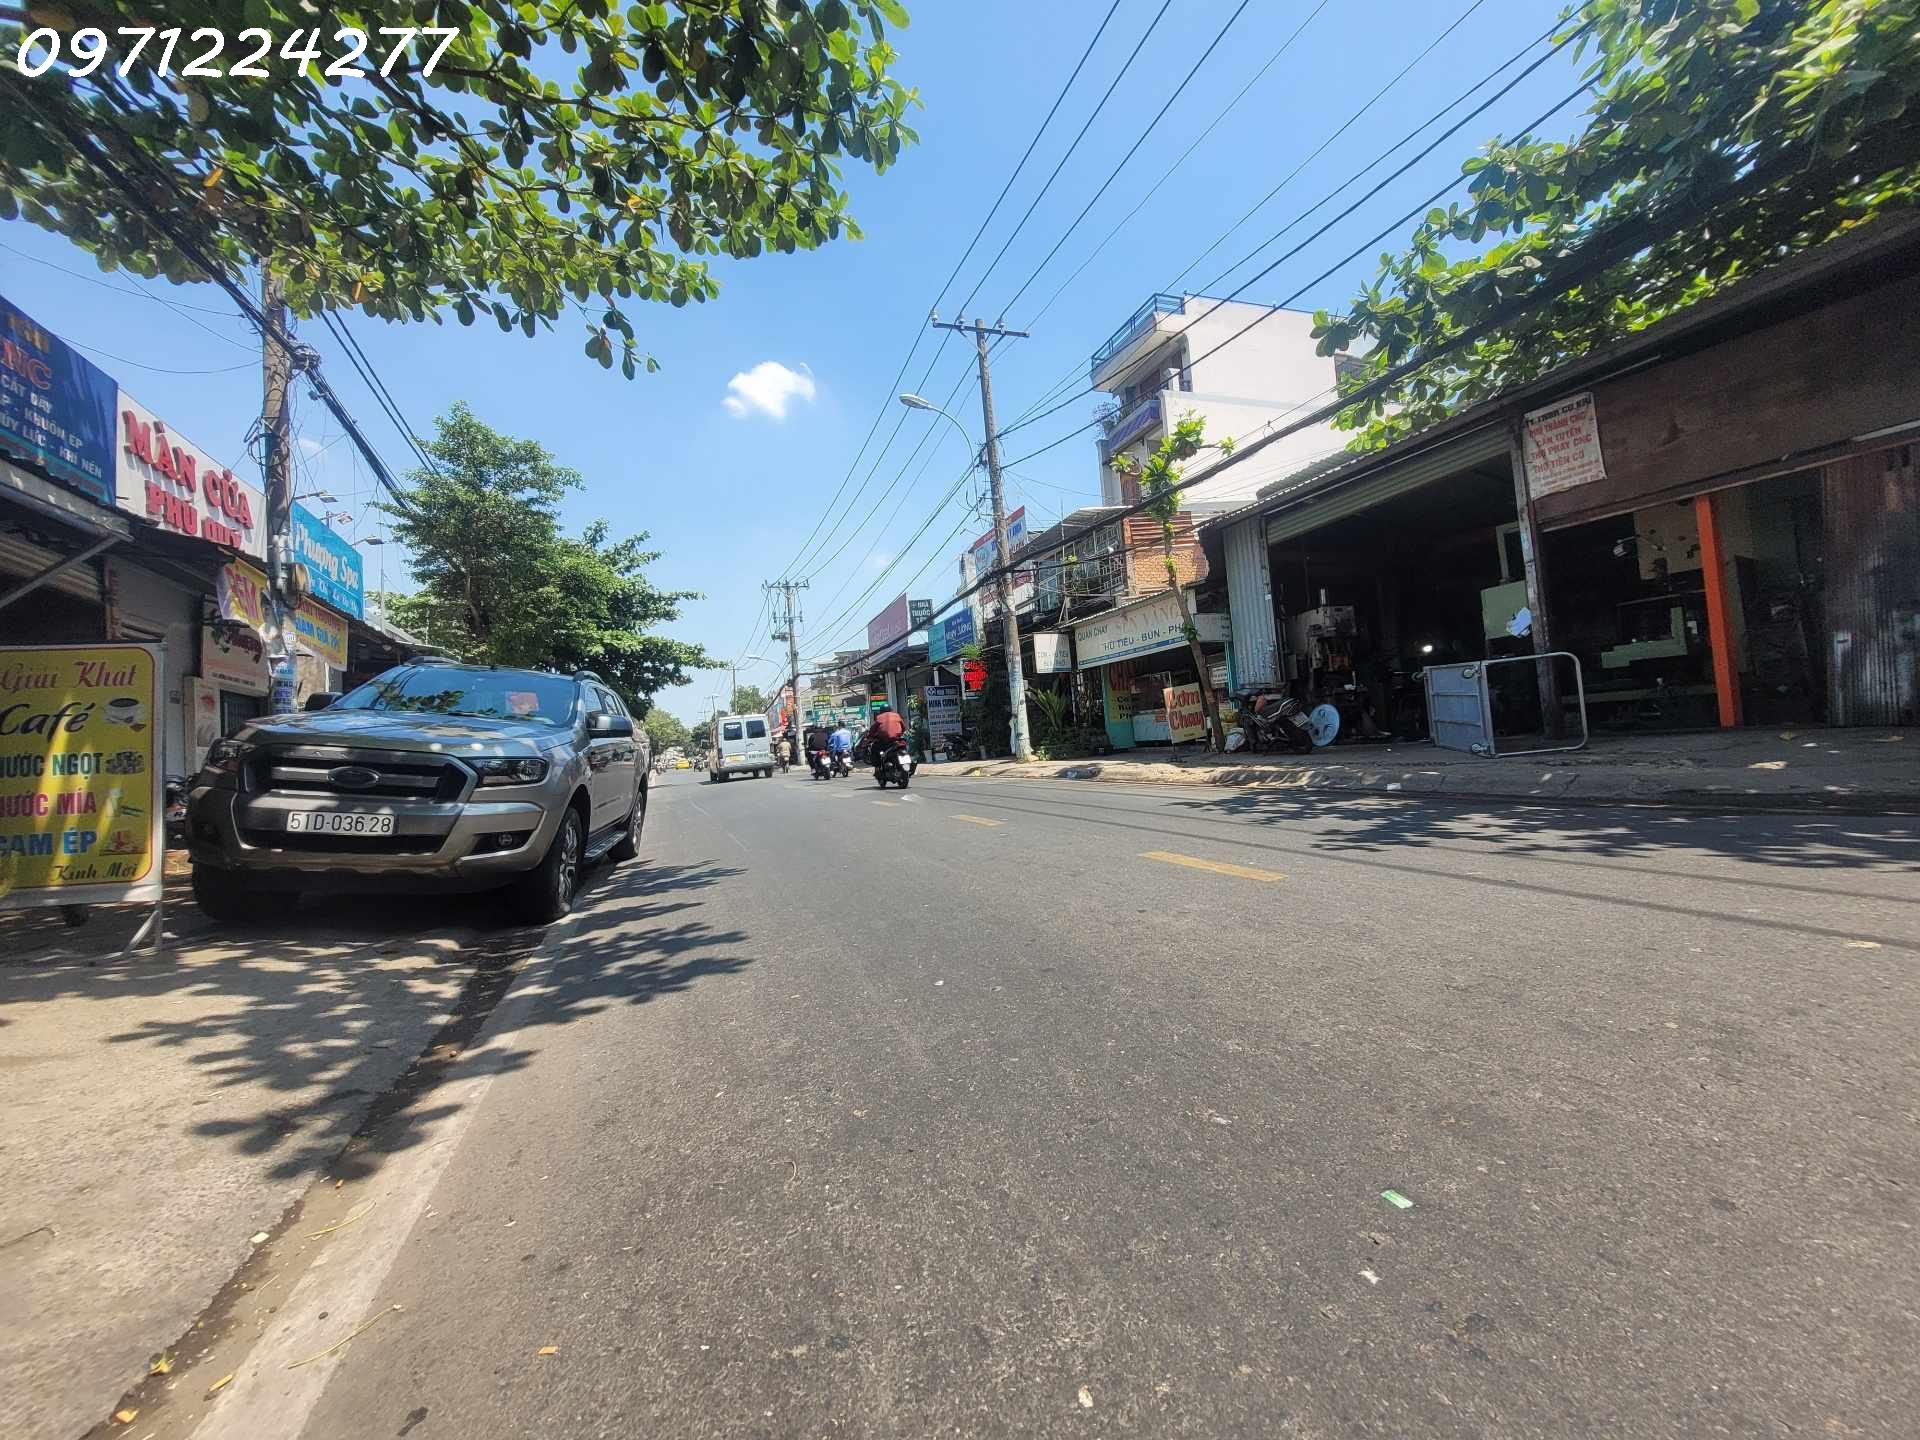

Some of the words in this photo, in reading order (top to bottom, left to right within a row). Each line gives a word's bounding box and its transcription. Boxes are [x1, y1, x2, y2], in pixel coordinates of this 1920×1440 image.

[122, 410, 197, 493] MÀN
[202, 468, 254, 530] CỬA
[0, 702, 96, 744] Café
[52, 752, 103, 780] NGỌT
[56, 787, 97, 815] MÍA
[290, 813, 392, 833] 51D-036.28
[63, 826, 97, 854] ÉP
